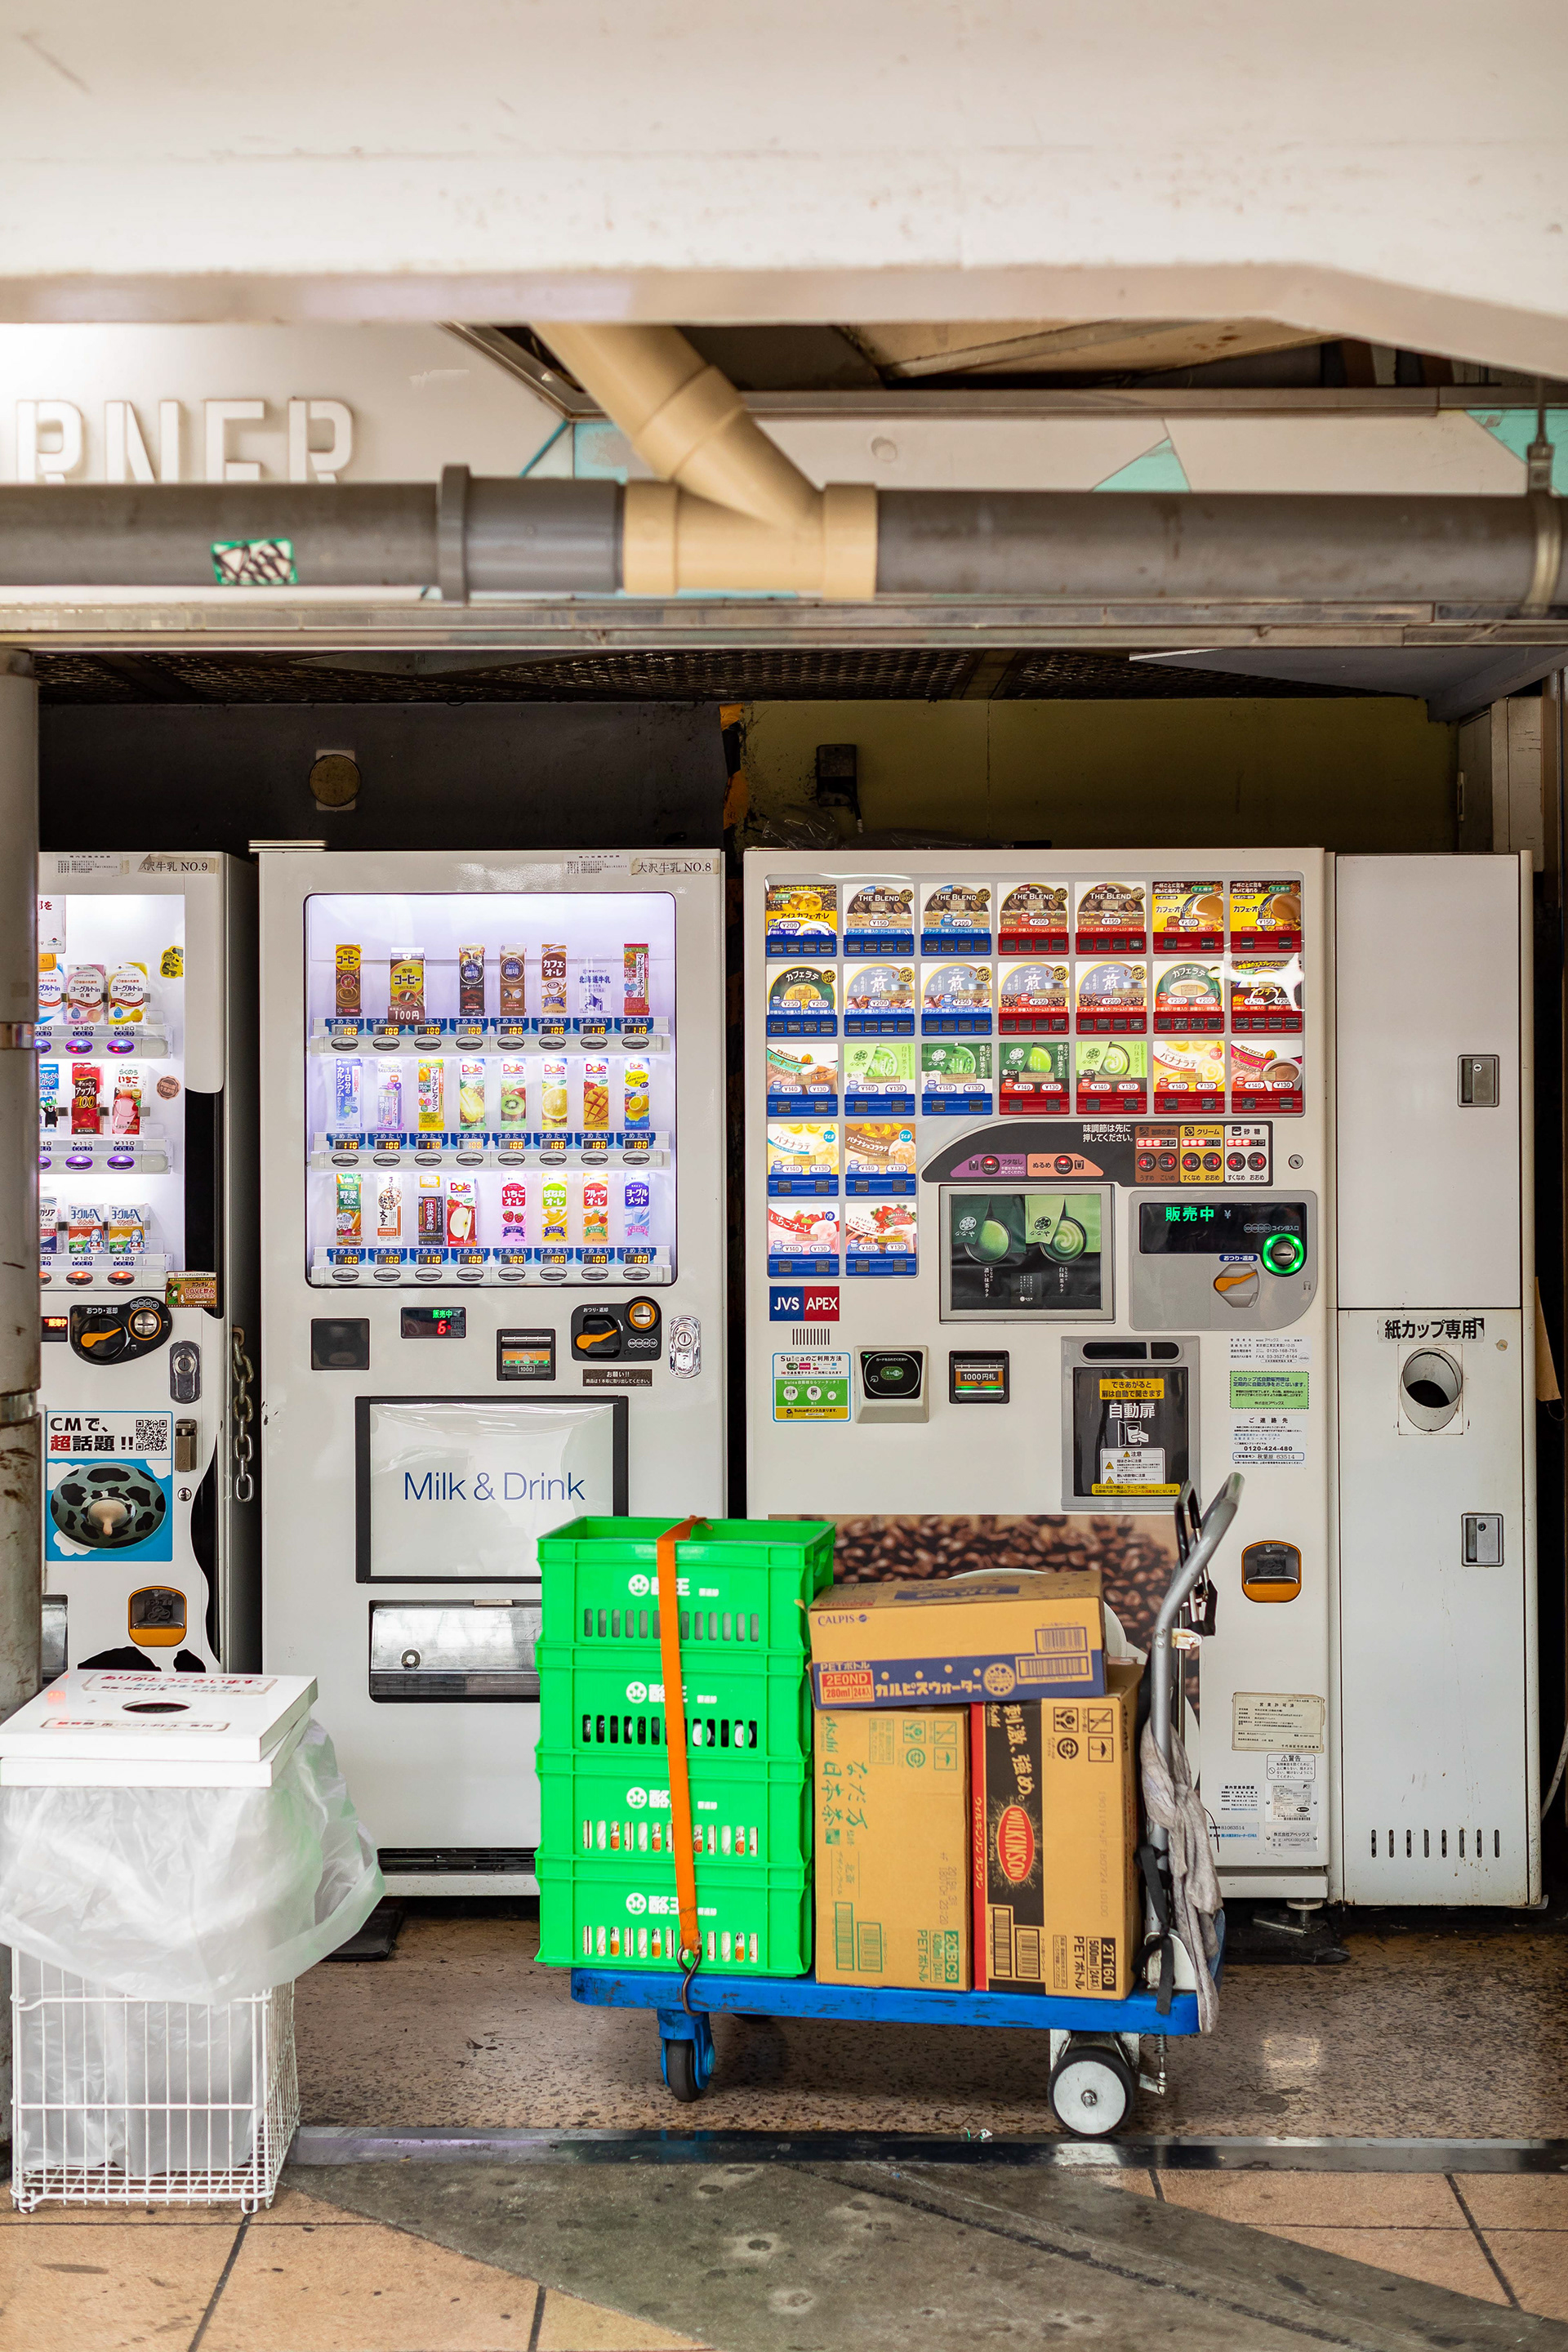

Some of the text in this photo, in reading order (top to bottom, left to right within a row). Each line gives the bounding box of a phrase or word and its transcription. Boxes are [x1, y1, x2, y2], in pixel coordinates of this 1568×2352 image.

[180, 862, 208, 871] NO.9
[637, 862, 681, 873] 大沢牛乳
[684, 862, 711, 873] NO.8
[336, 956, 359, 964] コーヒー
[785, 970, 820, 982] カフェラテ
[1172, 967, 1206, 978] カフェラテ
[394, 974, 421, 985] コーヒー
[394, 1010, 420, 1020] 100円
[633, 1027, 647, 1035] 110
[1160, 1053, 1197, 1068] バナナラテ
[461, 1064, 483, 1073] Dole
[503, 1064, 523, 1072] Dole
[586, 1063, 607, 1073] Dole
[118, 1076, 140, 1085] いちご
[336, 1067, 345, 1097] カルシウム
[75, 1087, 97, 1096] アップル
[1083, 1124, 1131, 1133] 味調節は先に
[774, 1135, 811, 1151] バナナラテ
[846, 1136, 889, 1152] バナナショコララテ
[1083, 1134, 1134, 1143] 押してください。
[340, 1190, 358, 1199] 野菜
[502, 1189, 525, 1198] いちご
[543, 1189, 566, 1198] ばなな
[584, 1189, 607, 1197] フルーツ
[626, 1188, 648, 1197] ヨーグル
[628, 1197, 647, 1205] メット
[1165, 1206, 1214, 1222] 販売中
[773, 1296, 838, 1311] JVS APEX
[86, 1307, 118, 1315] おつり・返却
[432, 1309, 453, 1319] 販売中
[437, 1320, 448, 1334] 6
[1384, 1318, 1477, 1339] 紙カップ専用
[1101, 1390, 1162, 1398] 扉は自動で開きます
[1109, 1402, 1155, 1419] 自動扉
[403, 1471, 586, 1501] Milk & Drink
[817, 1614, 855, 1628] CALPIS
[820, 1661, 871, 1672] PETボトル
[100, 1674, 262, 1686] ありがとうございます。
[826, 1687, 851, 1699] 280ml
[875, 1679, 982, 1698] カルピスウォーター
[1002, 1704, 1036, 1802] 刺激、強め。
[821, 1761, 844, 1826] 日本茶
[975, 1797, 984, 1889] ウィルキンソン タンサン
[1004, 1810, 1028, 1878] WILKINSON
[917, 1929, 929, 1982] PETボトル
[1089, 1940, 1099, 1967] 500ml
[1074, 1936, 1085, 1990] PETボトル
[1102, 1943, 1115, 1985] 2T160
